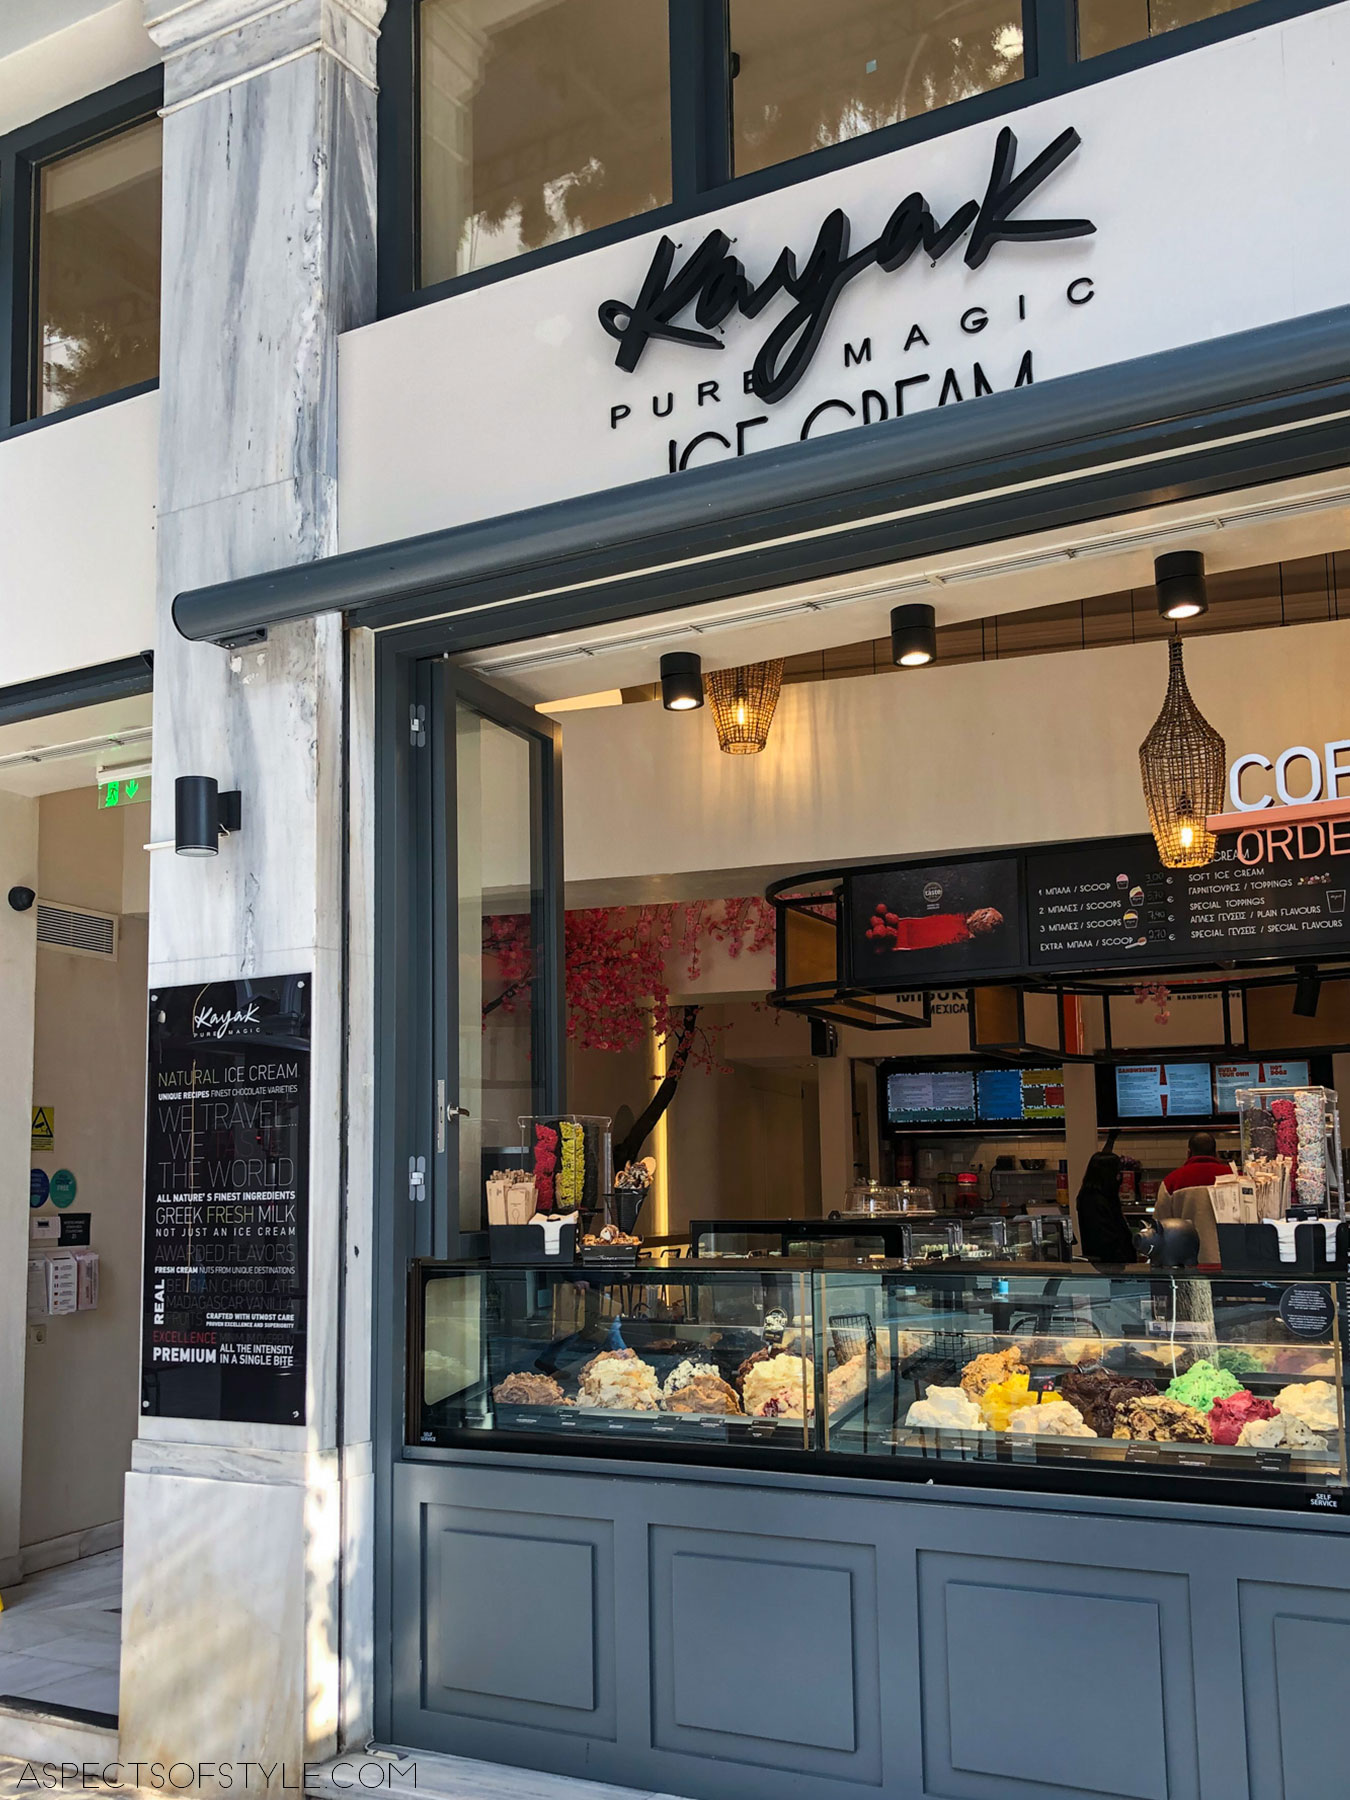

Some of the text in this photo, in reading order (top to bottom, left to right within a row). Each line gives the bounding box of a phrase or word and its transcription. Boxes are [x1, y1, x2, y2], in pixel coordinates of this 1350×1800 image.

[598, 126, 1097, 404] Kayak
[610, 277, 1096, 429] PURE MAGIC
[1188, 868, 1265, 882] SOFT ICE CREAM
[1080, 883, 1111, 892] SCOOP
[1250, 879, 1293, 890] TOPPINGS
[1086, 900, 1122, 911] SCOOPS
[1189, 897, 1265, 911] SPECIAL TOPPINGS
[1257, 909, 1278, 918] PLAIN
[1280, 905, 1321, 917] FLAVOURS
[1086, 918, 1122, 929] SCOOPS
[1190, 928, 1224, 939] SPECIAL
[1267, 922, 1298, 933] SPECIAL
[1301, 919, 1343, 930] FLAVOURS
[1040, 942, 1063, 951] EXTRA
[1101, 936, 1133, 946] SCOOP
[1176, 992, 1218, 1001] SANDWICH
[930, 1003, 969, 1015] MEXICA
[194, 1002, 261, 1040] Kayak
[193, 1027, 261, 1039] PURE MAGIC
[158, 1062, 298, 1088] NATURAL ICE CREAM
[157, 1084, 298, 1101] UNIQUE RECIPES FINEST CHOCOLATE VARIETIES
[158, 1103, 195, 1133] WE
[168, 1131, 206, 1160] WE
[158, 1158, 294, 1189] THE WORLD
[156, 1194, 172, 1203] ALL
[214, 1192, 242, 1202] FINEST
[242, 1190, 296, 1201] INGREDIENTS
[155, 1204, 296, 1225] GREEK FRESH MILK
[155, 1226, 296, 1237] NOT JUST AN ICE CREAM
[154, 1243, 296, 1263] AWARDED FLAVORS
[154, 1266, 296, 1275] FRESH CREAM NUTS FROM UNIQUE DESTINATIONS
[166, 1278, 295, 1294] BELGIAN CHOCOLATE
[153, 1278, 165, 1326] REAL
[166, 1295, 295, 1311] MADAGASCAR VANILLA
[166, 1311, 203, 1327] FRUITS
[205, 1312, 234, 1320] CRAFTED
[251, 1313, 277, 1321] UTMOST
[152, 1330, 217, 1345] EXCELLENCE
[152, 1347, 217, 1364] PREMIUM
[219, 1343, 294, 1356] ALL THE INTENSITY
[219, 1355, 294, 1367] IN A SINGLE BITE
[1310, 1498, 1338, 1508] SERVICE
[1315, 1493, 1331, 1501] SELF
